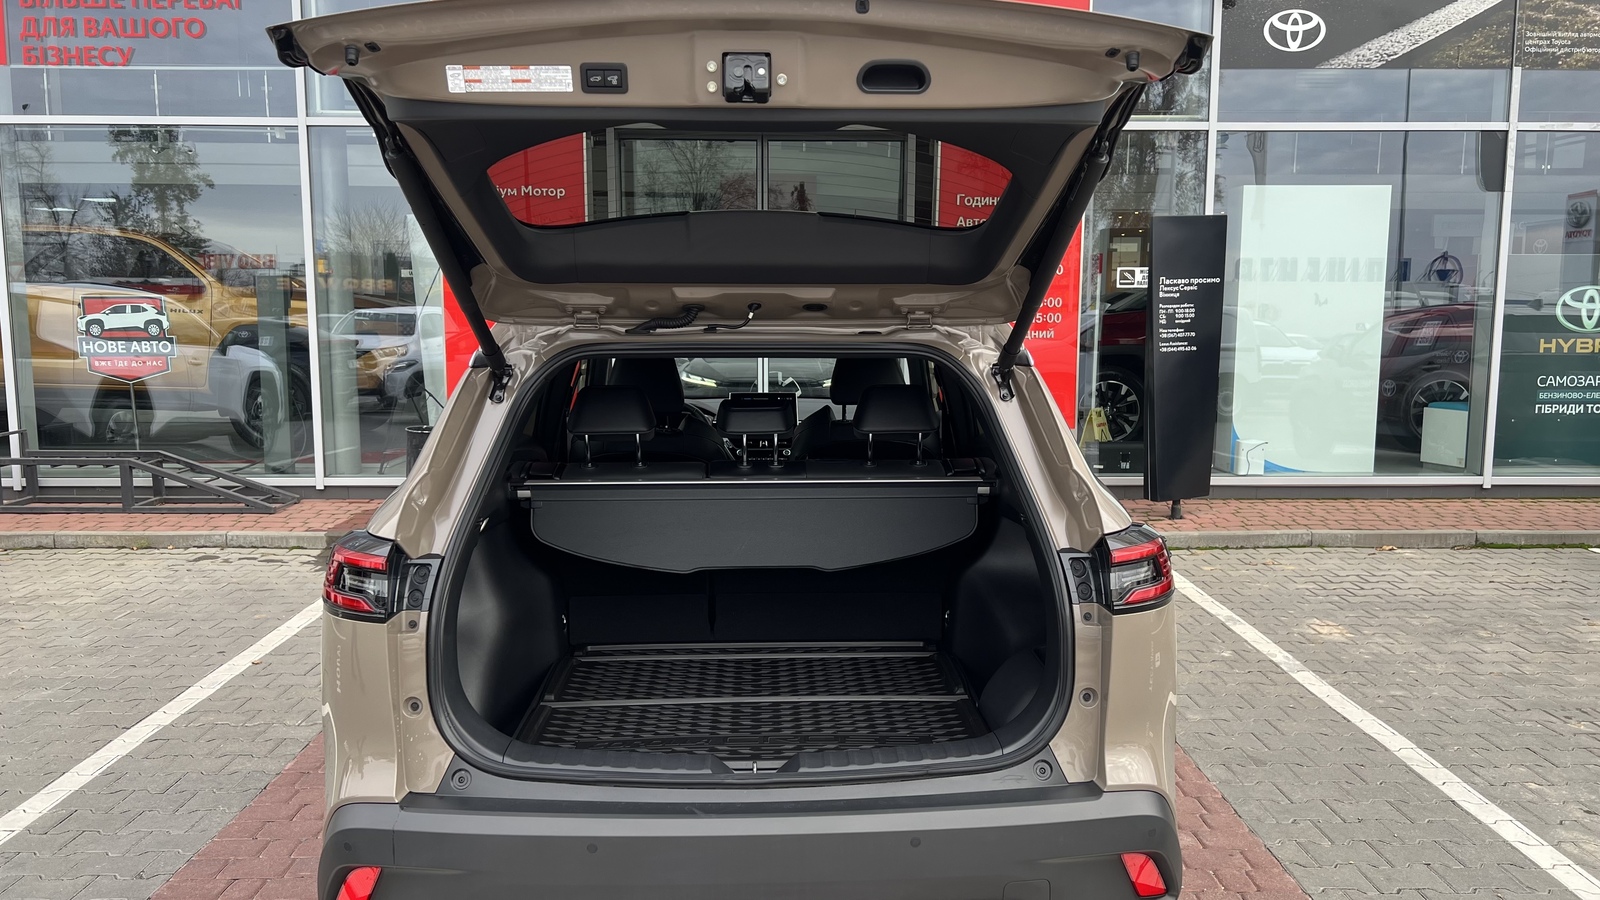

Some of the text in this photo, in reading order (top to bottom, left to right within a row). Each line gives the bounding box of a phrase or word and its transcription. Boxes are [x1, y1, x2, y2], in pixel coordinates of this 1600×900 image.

[20, 17, 206, 40] ДЛЯ ВАШОГО
[22, 46, 133, 66] БІЗНЕСУ
[521, 185, 566, 199] Мотор
[1159, 276, 1221, 285] Ласкаво просимо
[1040, 297, 1063, 308] :00
[82, 340, 172, 353] НОВЕ АВТО
[114, 359, 129, 367] ЇДЕ
[1534, 404, 1584, 416] ГІБРИДИ
